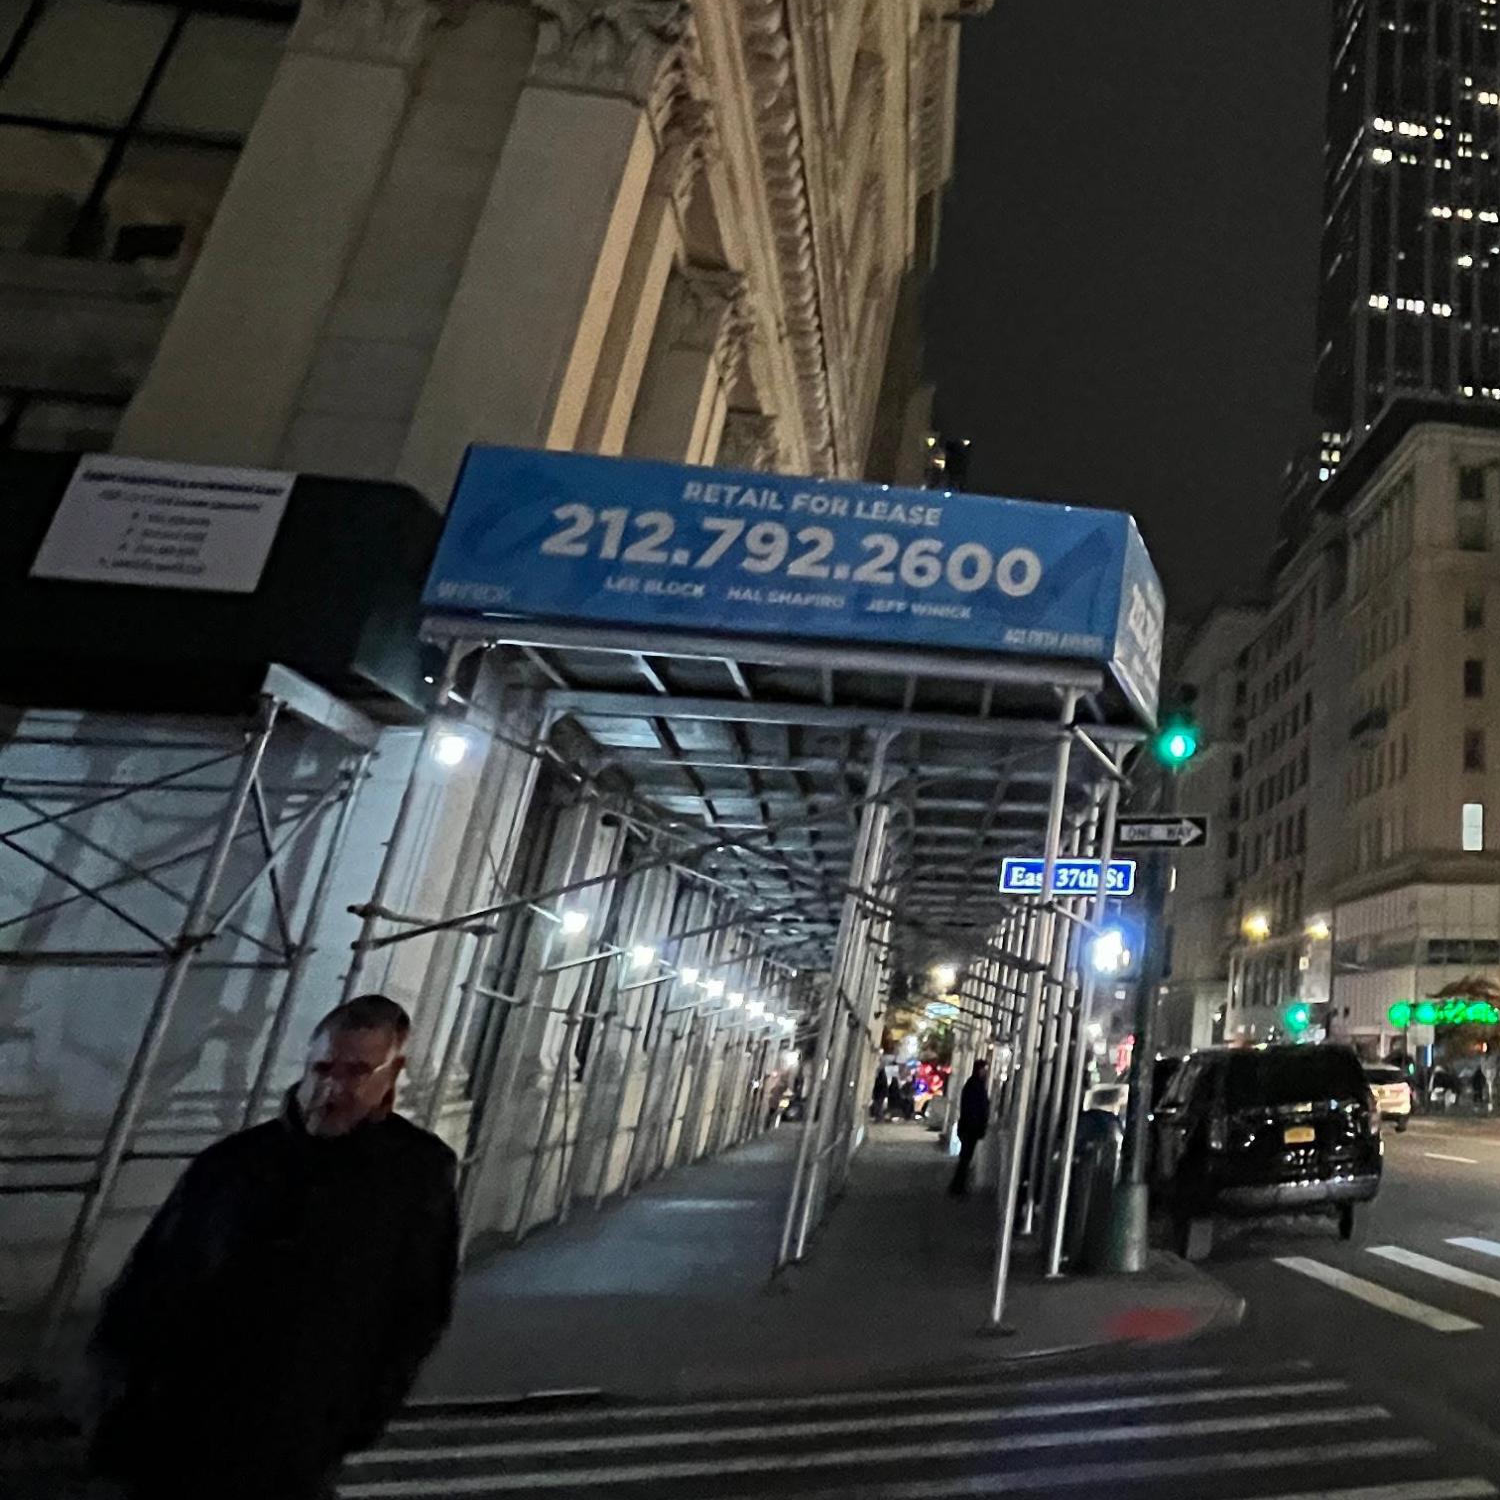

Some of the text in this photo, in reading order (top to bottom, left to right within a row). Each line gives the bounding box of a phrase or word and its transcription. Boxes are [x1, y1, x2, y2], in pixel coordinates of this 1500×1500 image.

[682, 481, 942, 528] RETAIL FOR LEASE
[541, 503, 1042, 598] 212.792.2600
[643, 579, 706, 599] BLOCK
[727, 587, 846, 610] HAL SHAPIRO
[865, 599, 973, 620] JEFF WINICK
[1127, 826, 1193, 840] ONE WAY
[1010, 866, 1125, 889] Eas 37th St
